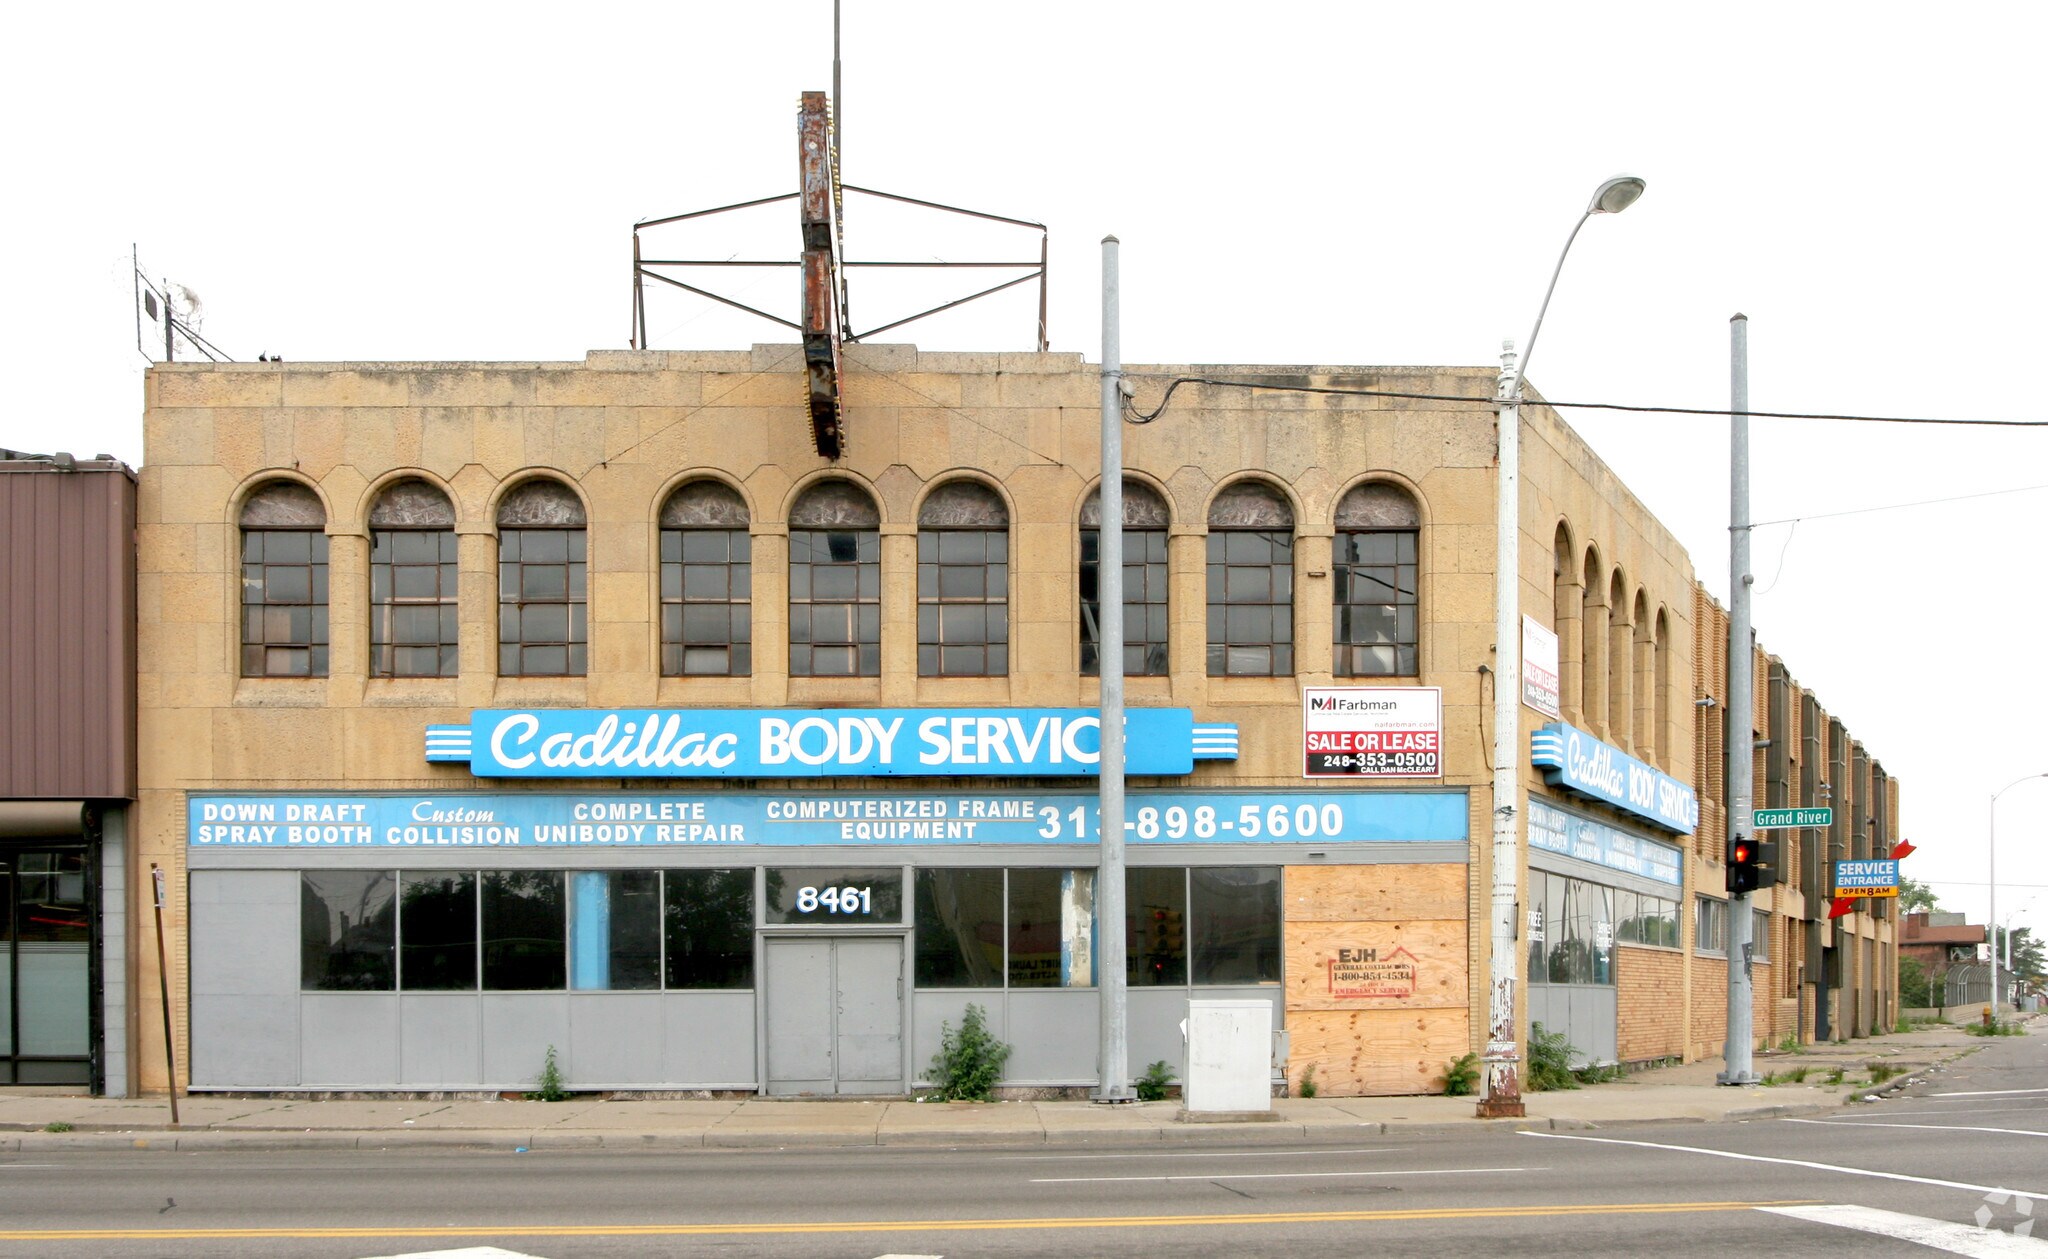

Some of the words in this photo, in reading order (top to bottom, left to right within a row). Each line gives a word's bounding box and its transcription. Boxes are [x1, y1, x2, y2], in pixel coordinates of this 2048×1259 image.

[1311, 695, 1336, 710] NAI
[1339, 699, 1397, 711] Farbman
[1374, 721, 1435, 729] naifarbman.com
[490, 713, 738, 769] Cadillac
[760, 717, 904, 765] BODY
[918, 716, 1126, 765] SERVIC
[1307, 733, 1352, 750] SALE
[1354, 733, 1379, 750] OR
[1382, 733, 1437, 750] LEASE
[1323, 752, 1436, 767] 248-353-0500
[1360, 766, 1380, 774] CALL
[1567, 732, 1623, 798] Cadillac
[1629, 763, 1656, 810] BODY
[1659, 778, 1691, 826] SERVICE
[204, 803, 275, 821] DOWN
[286, 804, 366, 822] DRAFT
[411, 801, 494, 823] Custom
[574, 803, 705, 821] COMPLETE
[766, 800, 947, 819] COMPUTERIZED
[958, 800, 1035, 818] FRAME
[1757, 811, 1793, 825] Grand
[1796, 810, 1827, 824] River
[1038, 804, 1343, 839] 31-898-5600
[198, 825, 278, 843] SPRAY
[288, 825, 371, 844] BOOTH
[386, 826, 520, 845] COLLISION
[534, 825, 646, 843] UNIBODY
[656, 824, 745, 842] REPAIR
[841, 821, 977, 840] EQUIPMENT
[1838, 861, 1894, 876] SERVICE
[1838, 875, 1893, 886] ENTRANCE
[1842, 887, 1866, 895] OPEN
[796, 886, 871, 914] 8461
[1527, 910, 1542, 927] FREE
[1339, 948, 1376, 963] EJH
[1364, 963, 1410, 971] CONTRACRS
[1335, 987, 1377, 995] EMERGENCY
